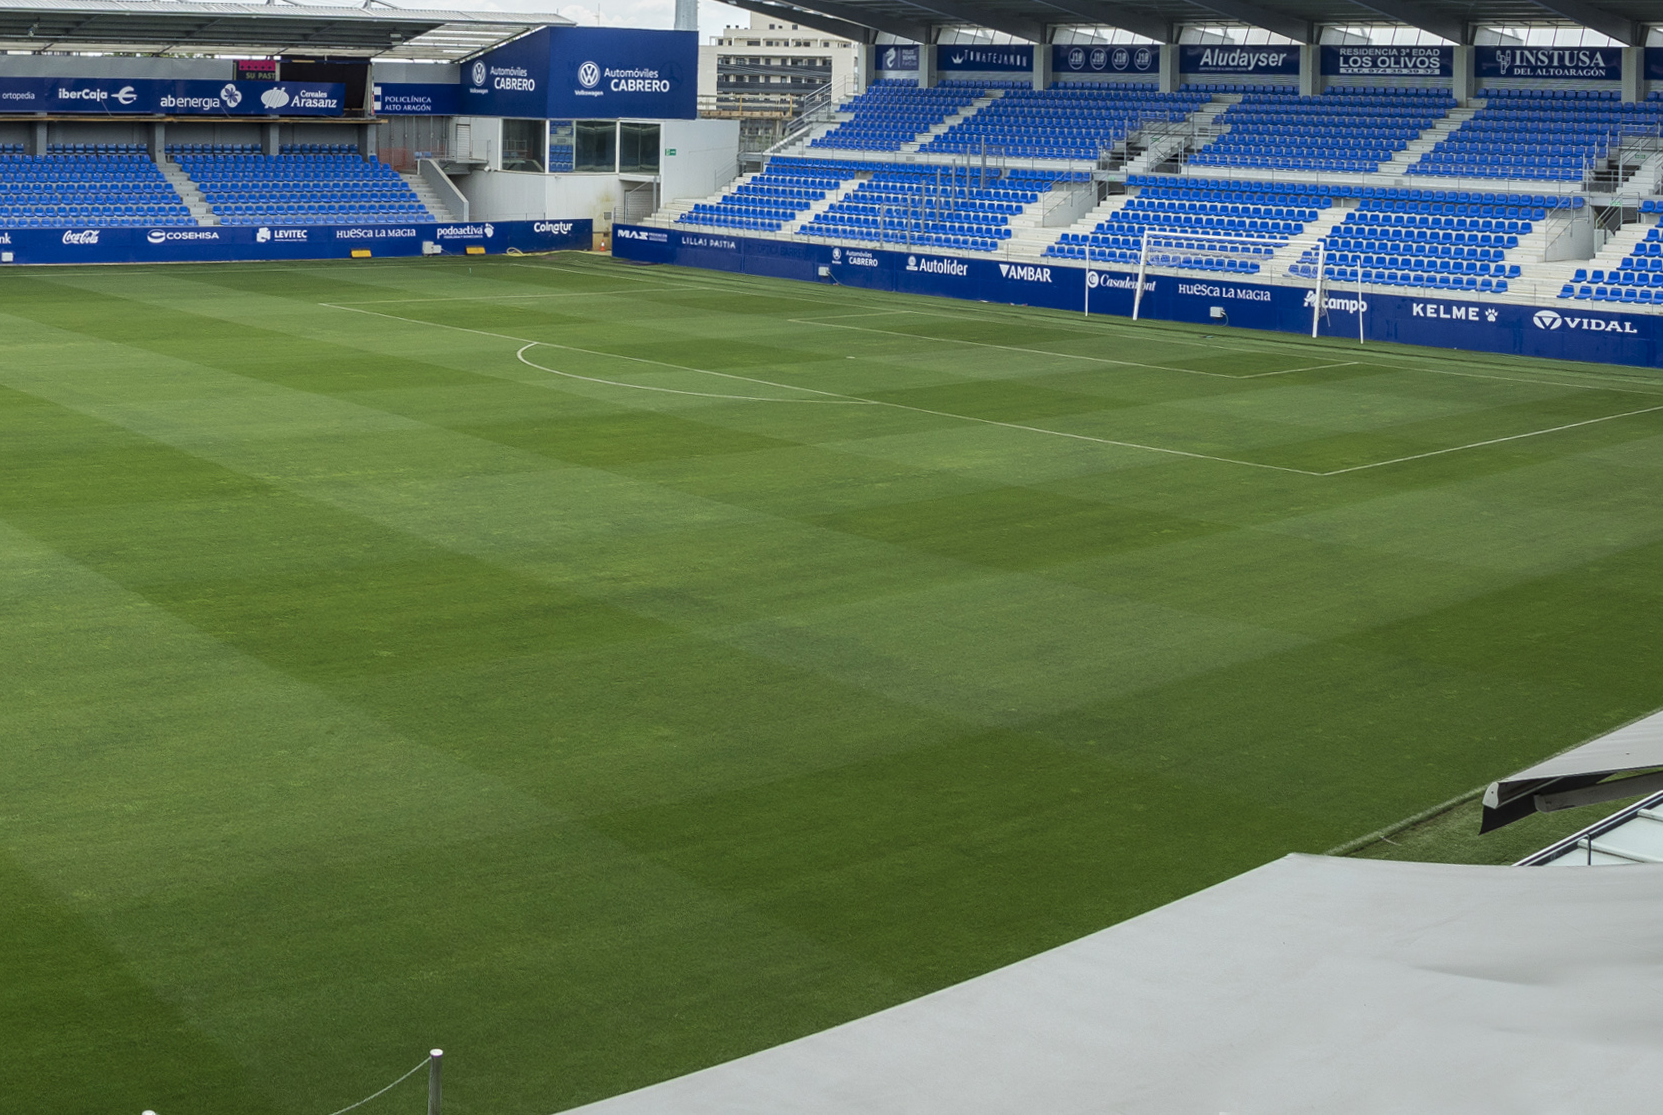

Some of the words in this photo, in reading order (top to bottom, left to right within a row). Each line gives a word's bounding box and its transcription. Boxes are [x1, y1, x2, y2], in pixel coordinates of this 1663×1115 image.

[1340, 48, 1398, 56] RESIDENCIA
[1200, 48, 1286, 70] Aludayser
[1340, 56, 1372, 67] LOS
[1377, 56, 1440, 68] OLIVOS
[1514, 50, 1605, 67] INSTUSA
[490, 66, 527, 77] Automóviles
[604, 68, 659, 79] Automóviles
[1533, 67, 1606, 76] ALTOARAGÓN
[494, 77, 535, 92] CABRERO
[611, 79, 670, 93] CABRERO
[2, 91, 35, 101] ortopedia
[58, 88, 108, 102] iberCaja
[300, 89, 327, 98] Cereales
[385, 94, 431, 103] POLICLÍNICA
[291, 96, 337, 108] Arasanz
[403, 103, 431, 111] ARAGÓN
[274, 229, 307, 238] LEVITEC
[437, 226, 483, 239] podoactiva
[534, 222, 573, 235] Colnatur
[167, 232, 219, 240] COSEHISA
[682, 237, 707, 246] LILLAS
[849, 257, 878, 267] CABRERO
[919, 258, 968, 276] Autolíder
[1009, 265, 1052, 283] AMBAR
[1413, 303, 1479, 320] KELME
[1564, 317, 1637, 334] VIDAL
